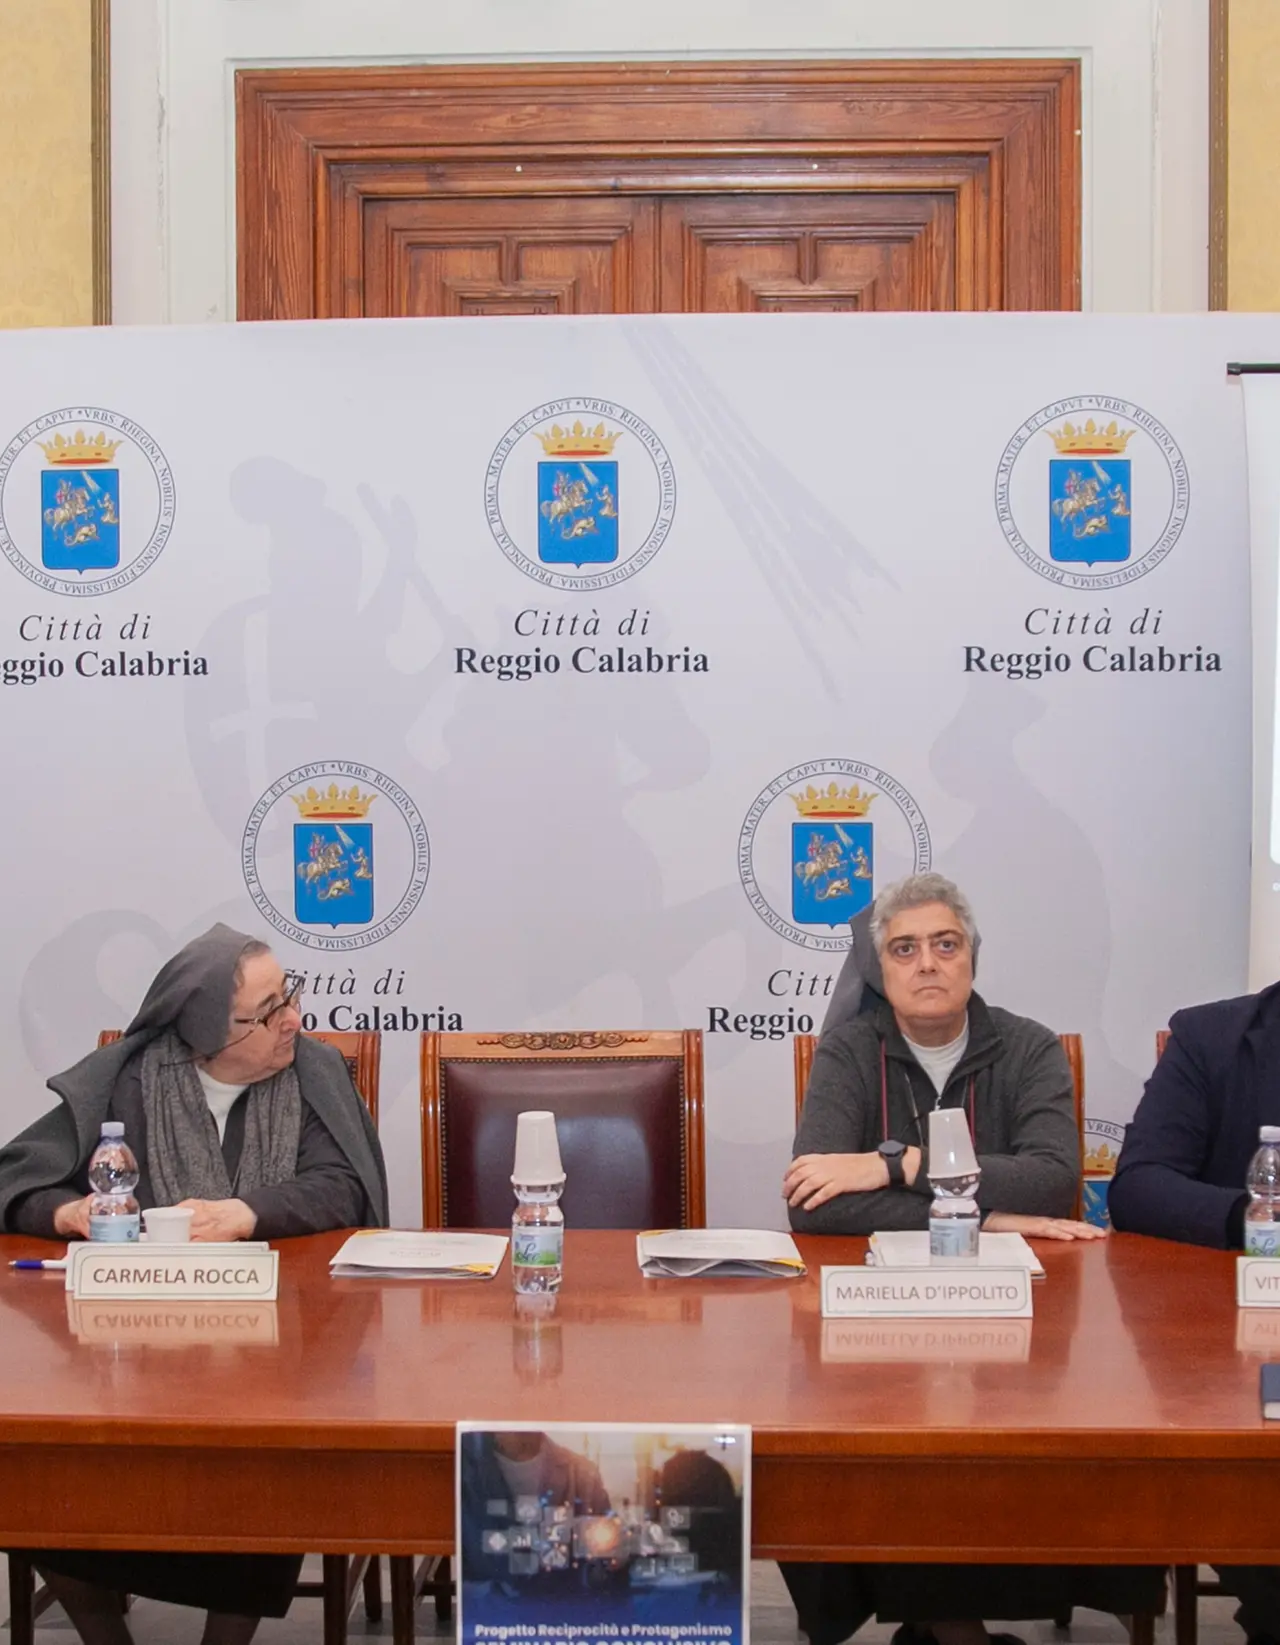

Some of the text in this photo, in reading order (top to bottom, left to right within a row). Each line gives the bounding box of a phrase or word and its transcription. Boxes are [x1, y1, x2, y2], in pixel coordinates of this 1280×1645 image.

[20, 614, 151, 641] Città di
[514, 609, 650, 636] Città di
[1024, 608, 1162, 636] Città di
[76, 650, 208, 677] Calabria
[454, 646, 710, 681] Reggio Calabria
[963, 645, 1222, 680] Reggio Calabria
[374, 970, 405, 995] di
[768, 970, 833, 996] Citt
[329, 1006, 463, 1032] Calabria
[706, 1006, 814, 1040] Reggio
[93, 1267, 260, 1285] CARMELA ROCCA
[836, 1286, 1018, 1299] MARIELLA D'IPPOLITO
[475, 1623, 732, 1639] Progetto Reciprocità e Protagonismo
